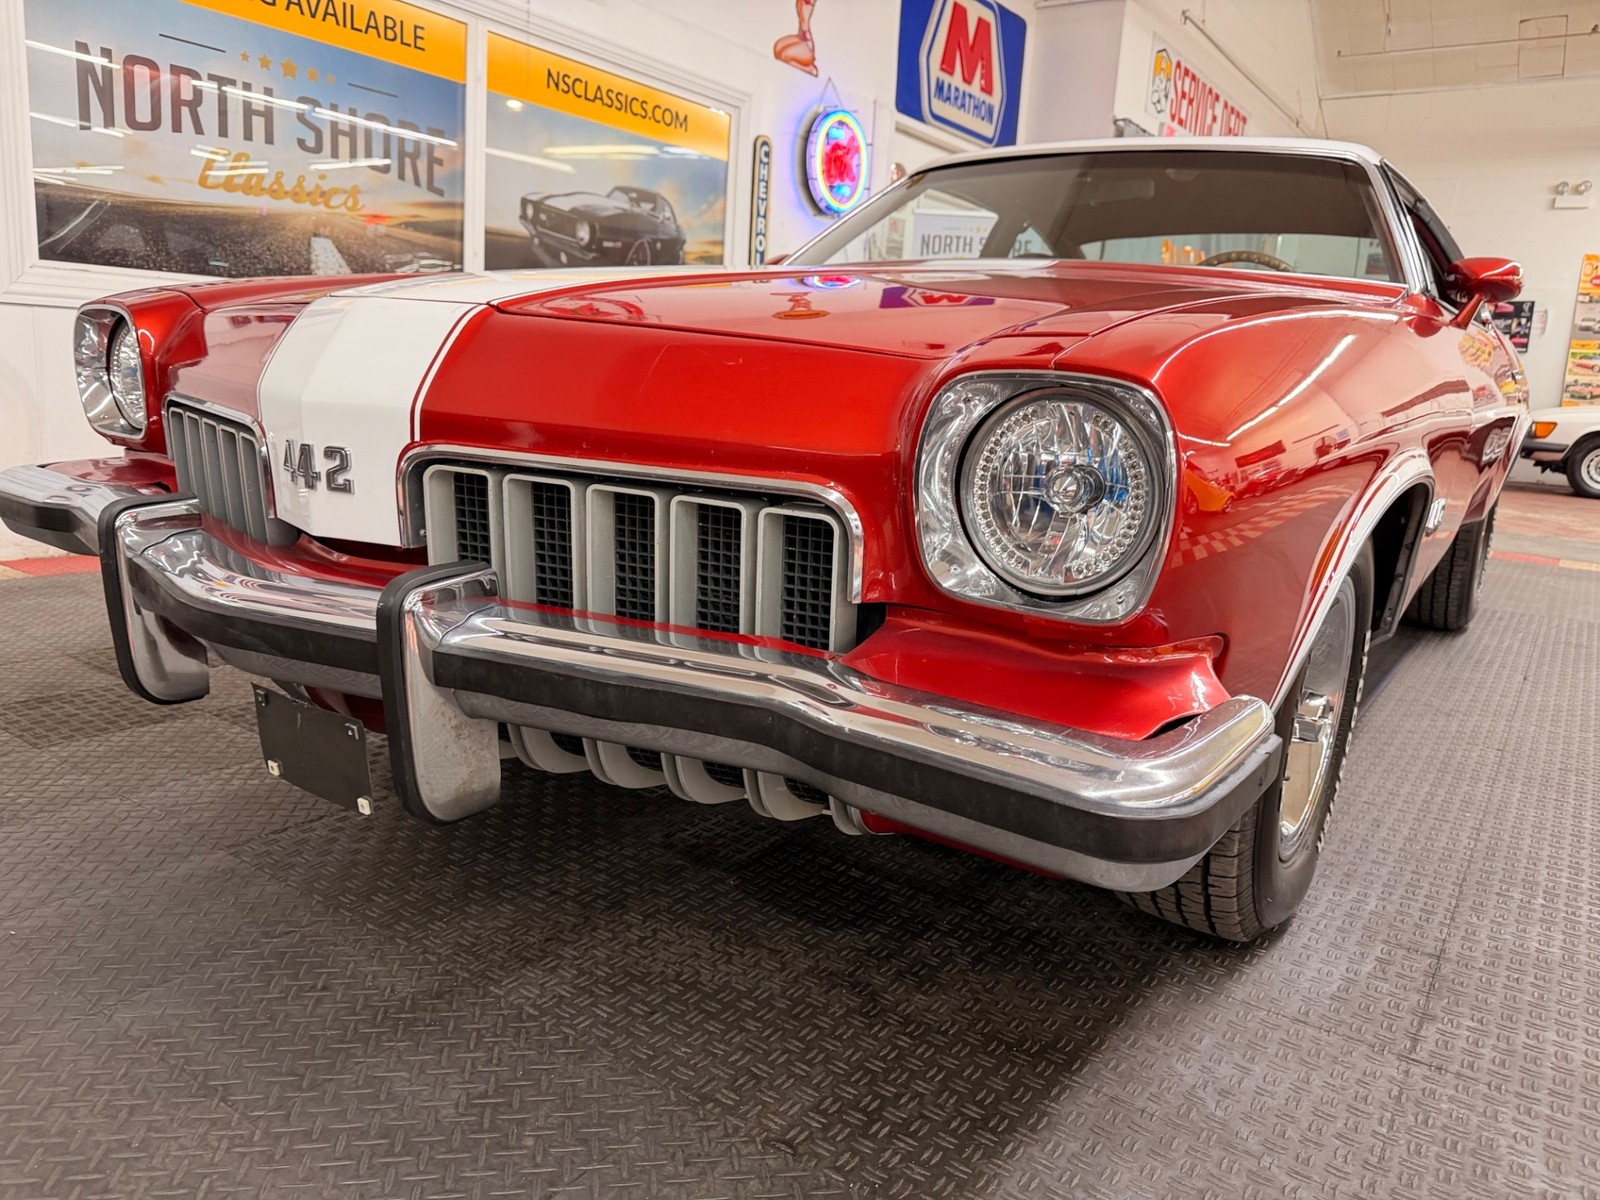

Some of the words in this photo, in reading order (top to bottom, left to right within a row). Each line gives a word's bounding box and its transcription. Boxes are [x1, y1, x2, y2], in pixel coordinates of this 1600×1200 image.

[74, 40, 275, 146] NORTH
[296, 96, 446, 198] SHORE
[546, 68, 689, 132] NSCLASSICS.COM
[934, 77, 994, 125] MARATHON
[1169, 60, 1220, 136] SERVICE
[197, 148, 366, 213] Classics
[920, 233, 973, 257] NORTH
[284, 438, 355, 495] 442
